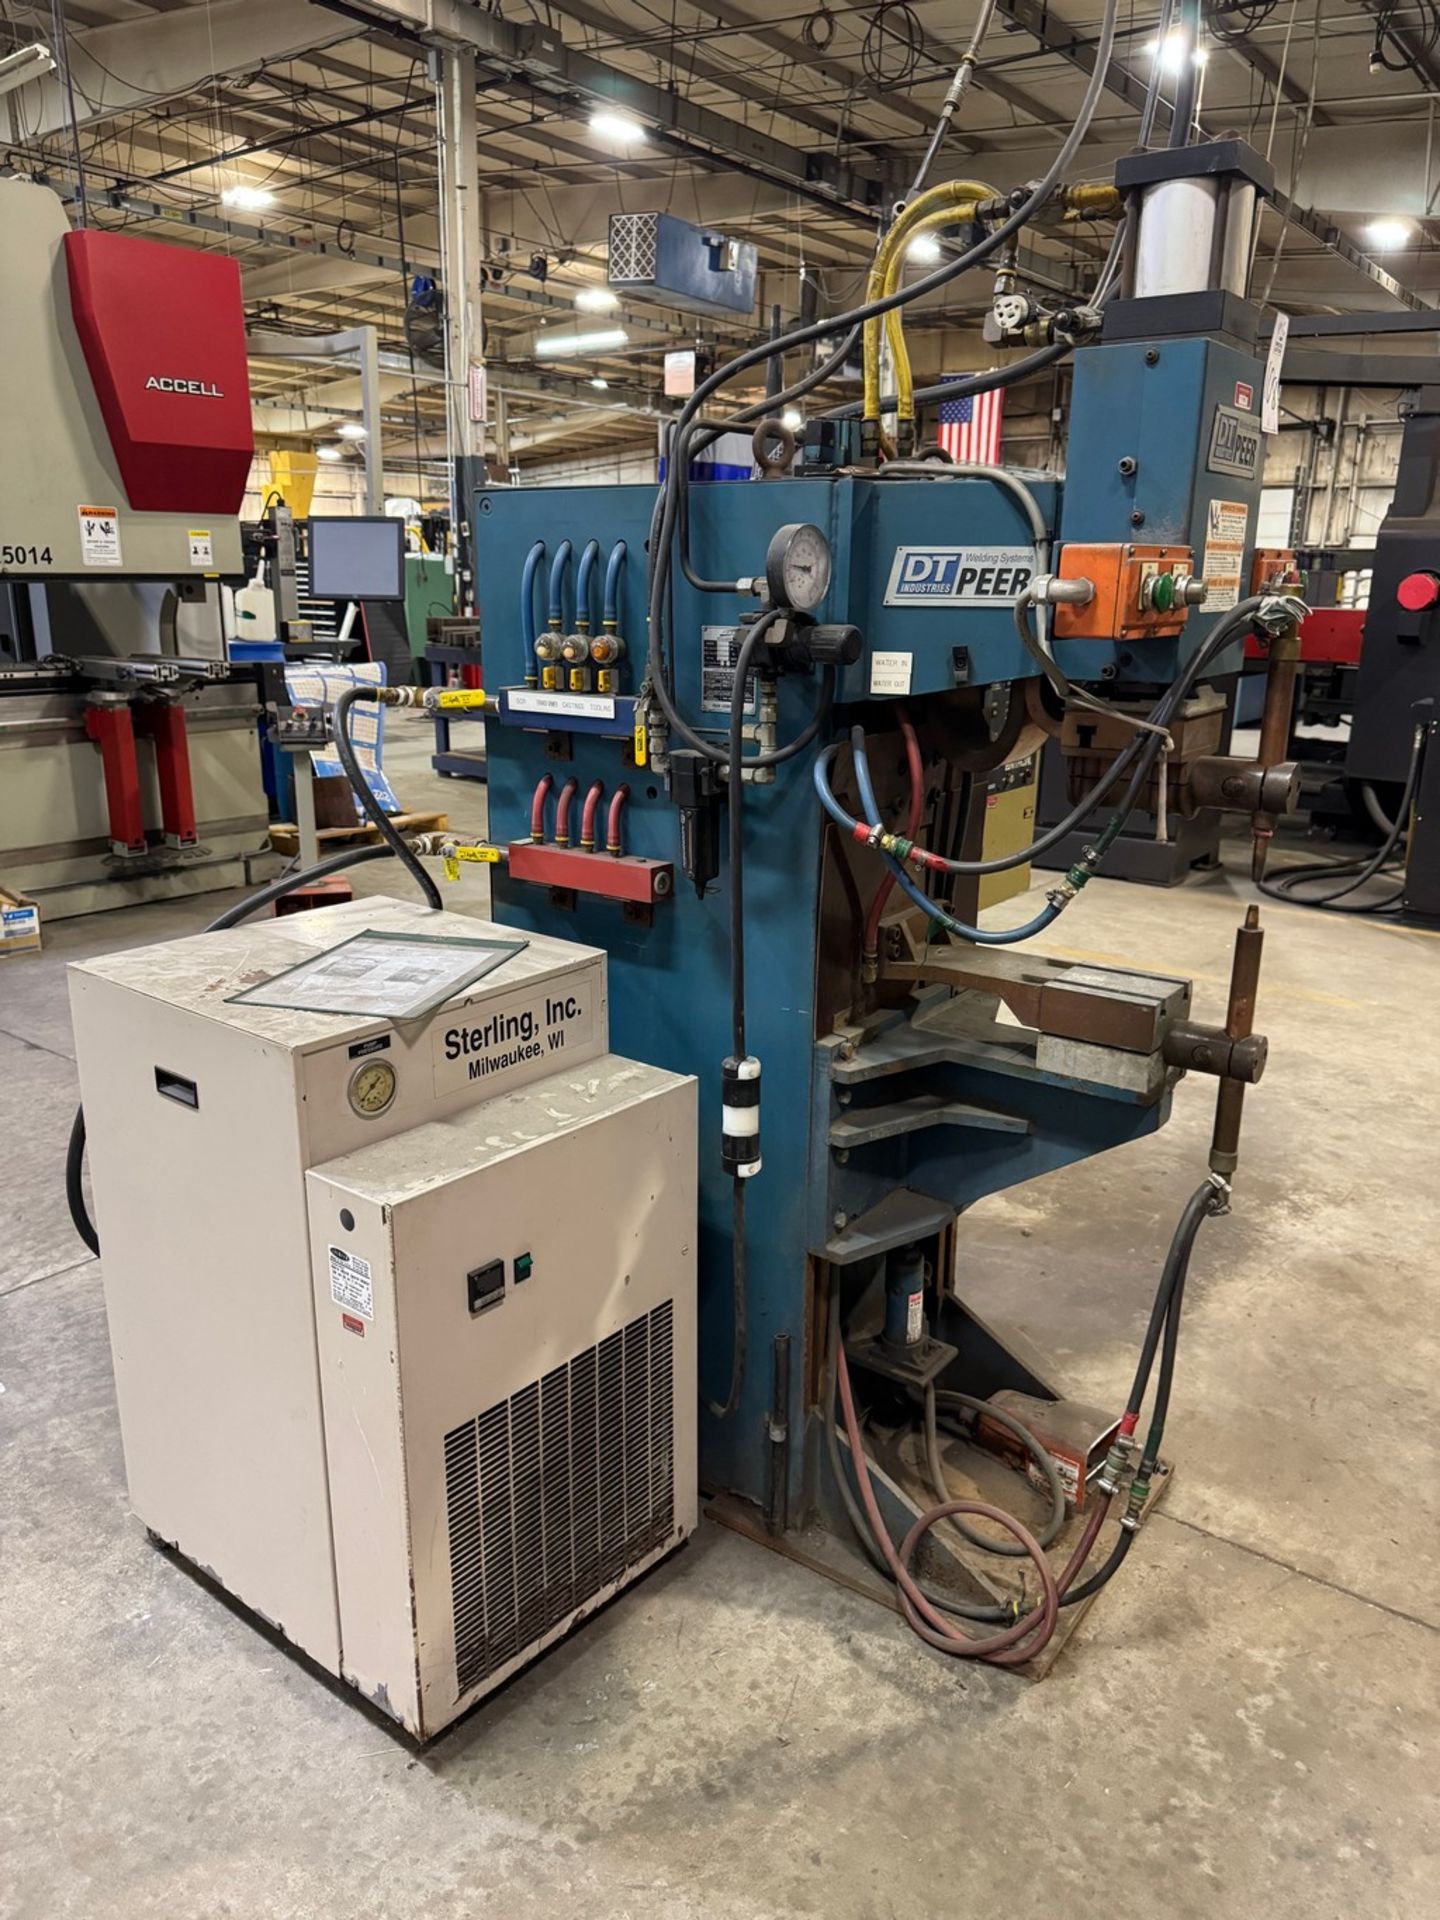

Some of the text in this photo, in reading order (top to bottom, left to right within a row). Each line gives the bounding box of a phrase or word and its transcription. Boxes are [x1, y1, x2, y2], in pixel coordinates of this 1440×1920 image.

[145, 376, 225, 398] ACCELL
[0, 545, 54, 565] 5014
[965, 553, 1034, 565] Welding Systems
[902, 555, 957, 583] DT
[955, 567, 1032, 596] PEER
[899, 583, 951, 594] INDUSTRIES
[444, 997, 582, 1060] Sterling, Inc.
[468, 1029, 565, 1080] Milwaukee, WI
